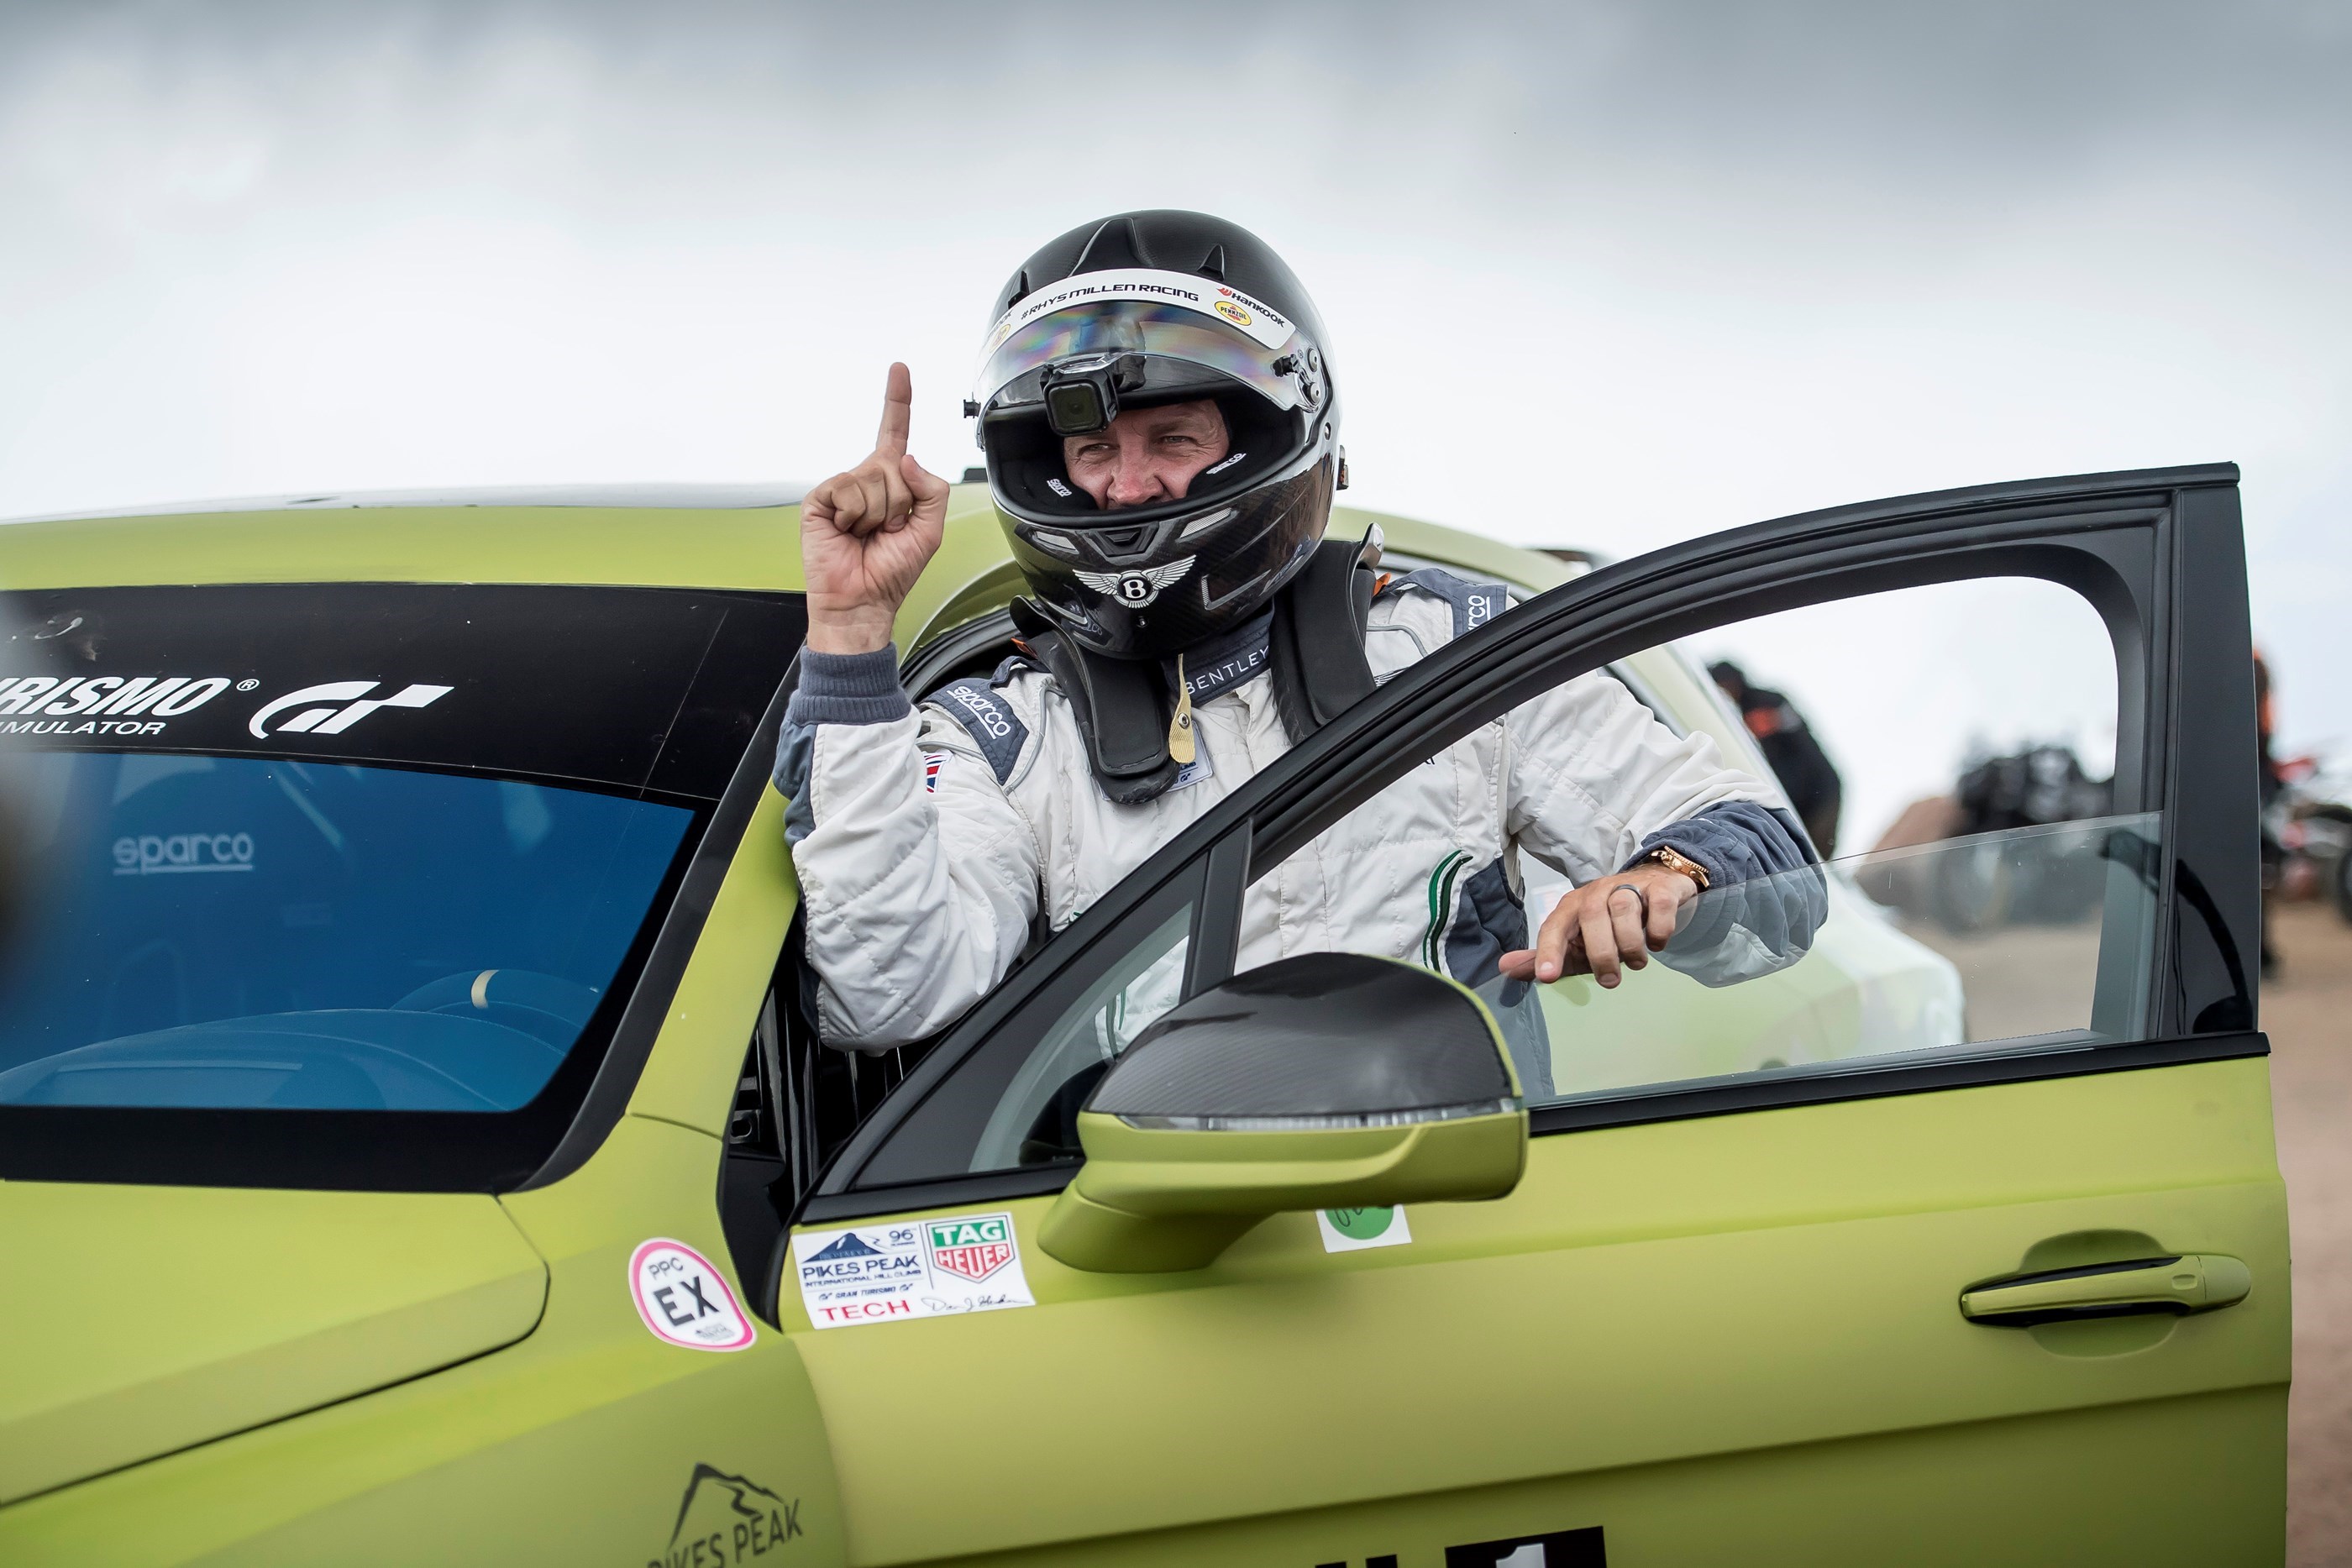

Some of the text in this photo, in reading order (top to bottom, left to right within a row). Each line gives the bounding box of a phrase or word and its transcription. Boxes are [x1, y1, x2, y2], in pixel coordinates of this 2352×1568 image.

[1068, 284, 1136, 300] MILLEN
[1140, 284, 1200, 302] RACING
[1220, 306, 1247, 320] PENNZOIL
[1185, 645, 1269, 695] BENTLEY
[948, 685, 1011, 738] sparco
[0, 721, 167, 736] MULATOR
[113, 833, 254, 875] sparco
[889, 1229, 914, 1242] 96
[934, 1220, 1005, 1246] TAG
[648, 1256, 684, 1281] PPC
[802, 1261, 862, 1281] PIKES
[866, 1255, 921, 1272] PEAK
[935, 1244, 1010, 1279] HEUER
[806, 1276, 872, 1287] INTERNATIONAL
[653, 1275, 720, 1327] EX
[817, 1299, 911, 1321] TECH
[733, 1497, 803, 1565] PEAK
